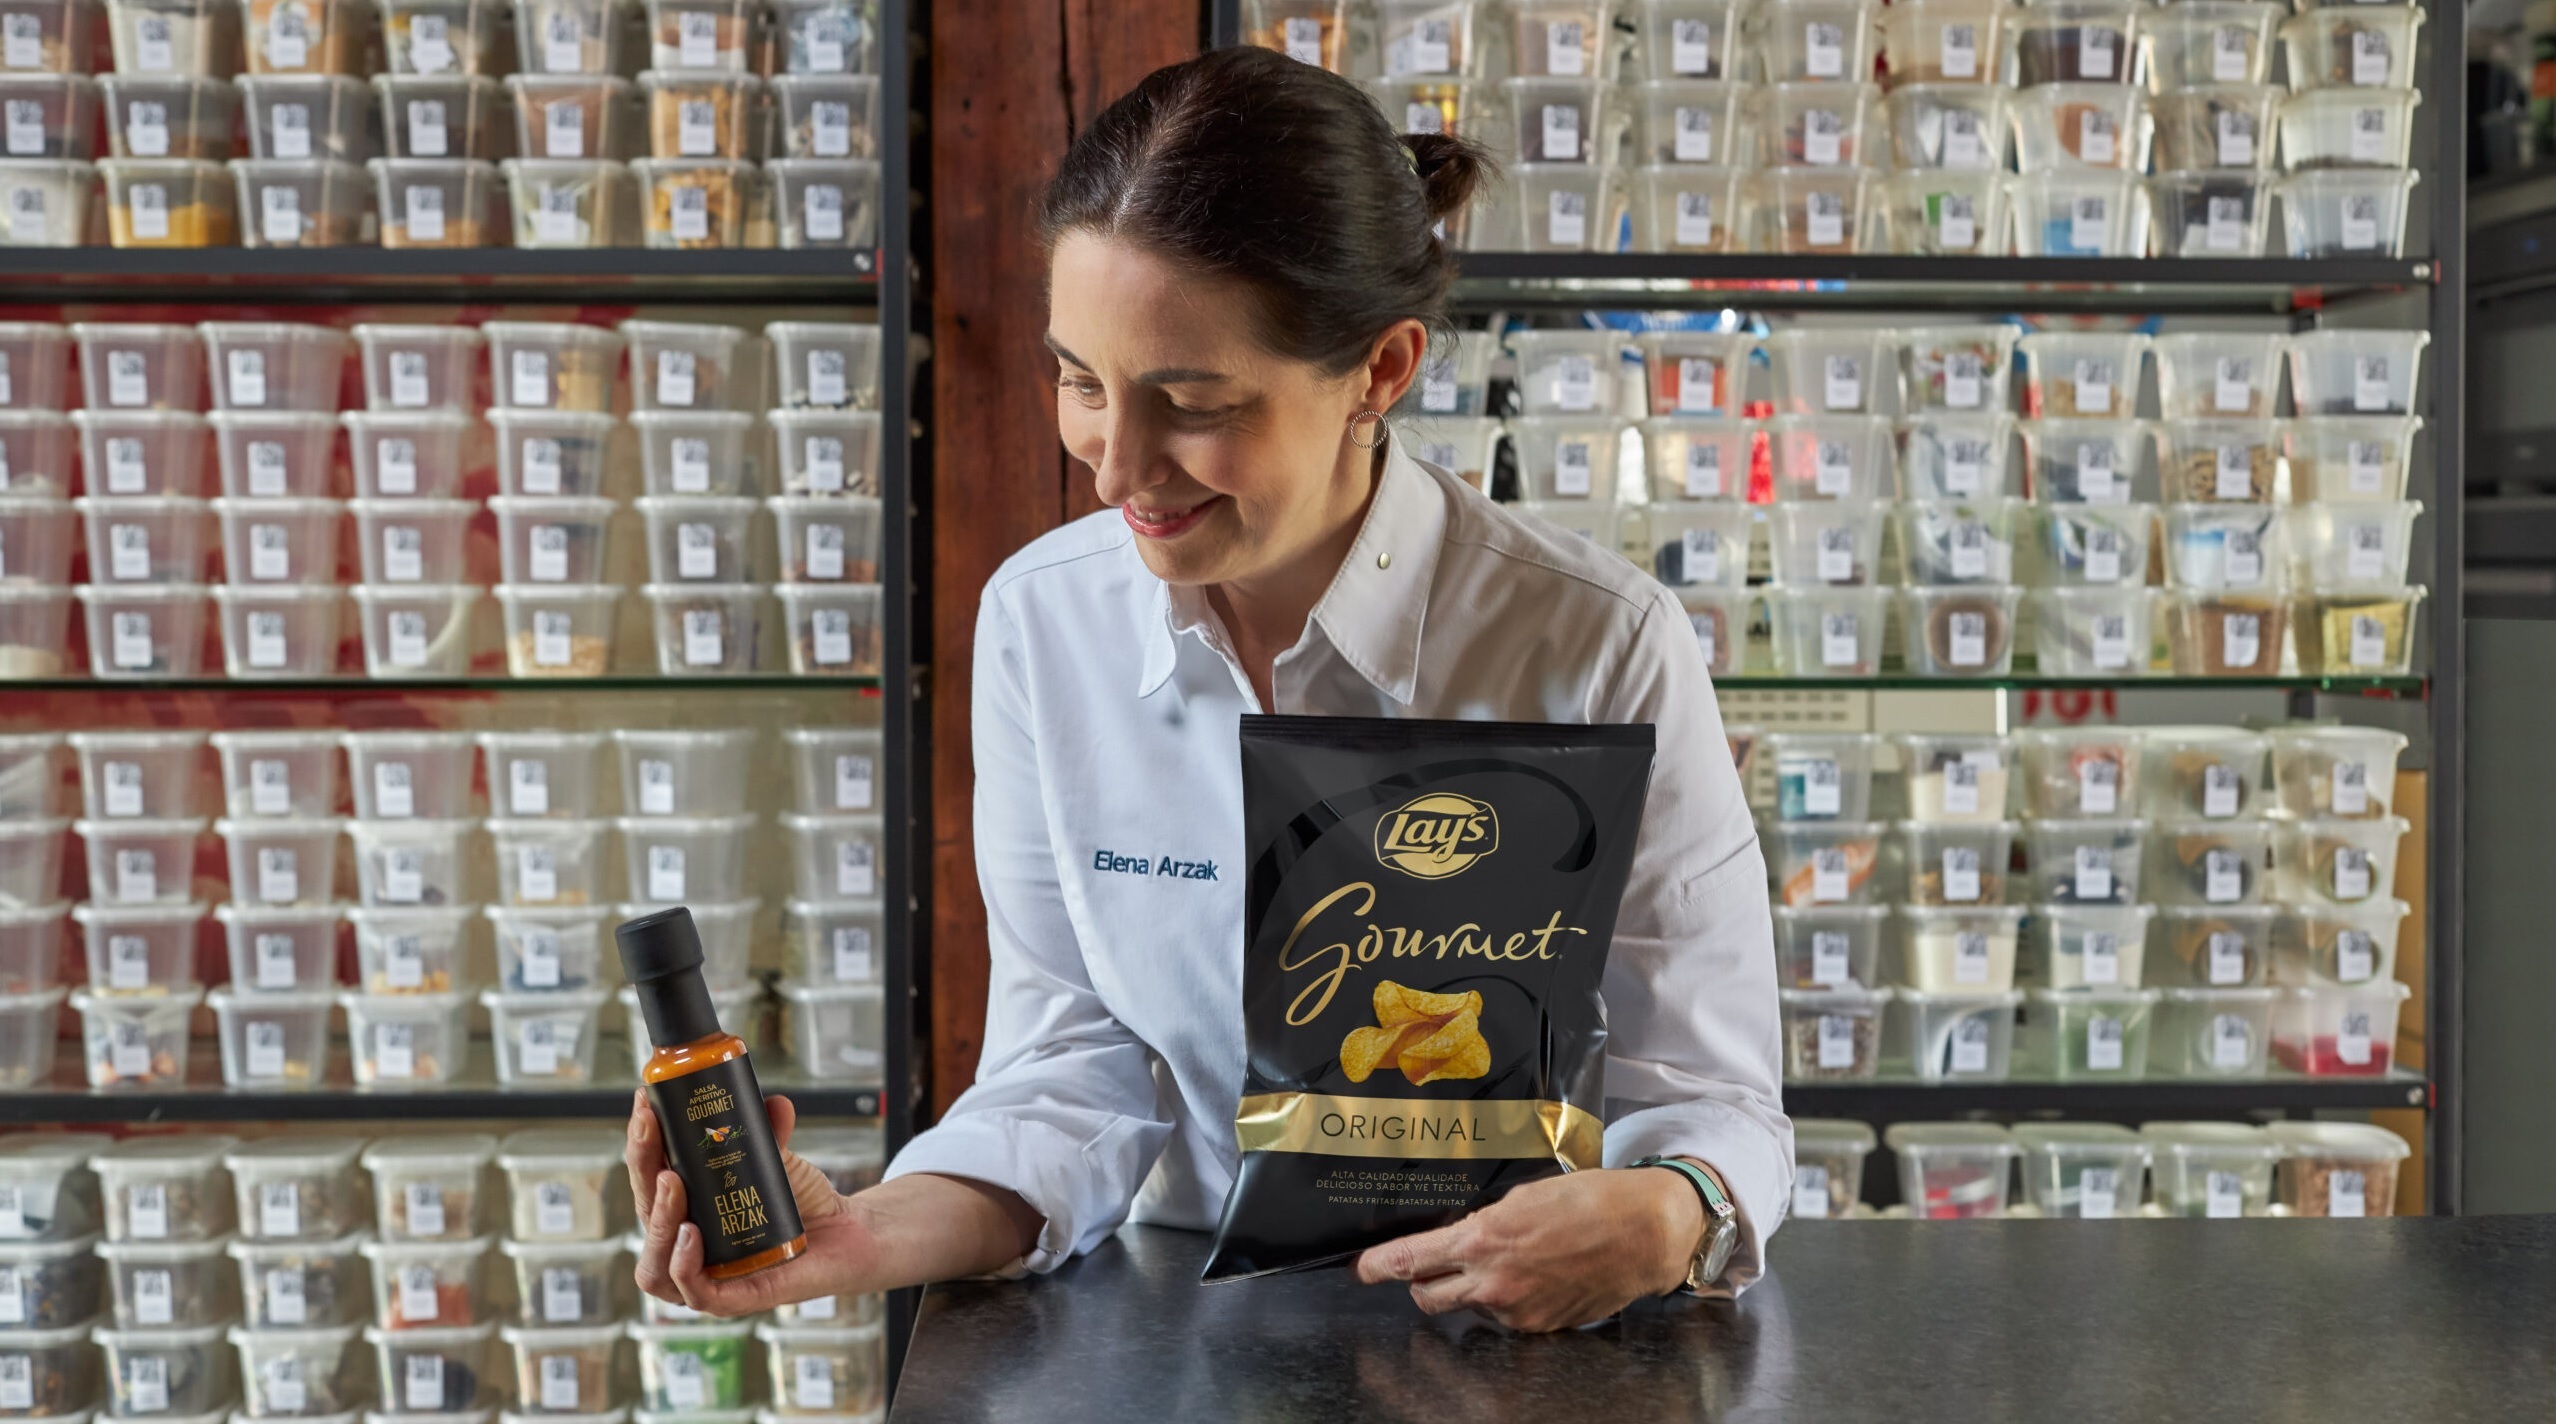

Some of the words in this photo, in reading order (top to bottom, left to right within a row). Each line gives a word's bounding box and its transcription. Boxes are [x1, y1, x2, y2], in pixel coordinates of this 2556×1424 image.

[1383, 811, 1489, 863] Lay's
[1094, 850, 1149, 875] Elena
[1157, 856, 1218, 881] Arzak
[1278, 881, 1588, 1026] Gourmet
[689, 1088, 727, 1105] APERITIVO
[693, 1083, 718, 1096] SALSA
[686, 1094, 735, 1122] GOURMET
[1321, 1113, 1486, 1141] ORIGINAL
[1316, 1179, 1373, 1190] DELICIOSO
[1376, 1183, 1410, 1191] SABOR
[1414, 1183, 1429, 1192] Y/E
[1433, 1183, 1480, 1192] TEXTURA
[1331, 1170, 1355, 1179] ALTA
[1358, 1171, 1468, 1182] CALIDAD/QUALIDADE
[714, 1185, 761, 1215] ELENA
[1328, 1195, 1364, 1204] PATATAS
[1366, 1197, 1435, 1206] FRITAS/BATATAS
[721, 1204, 769, 1236] ARZAK
